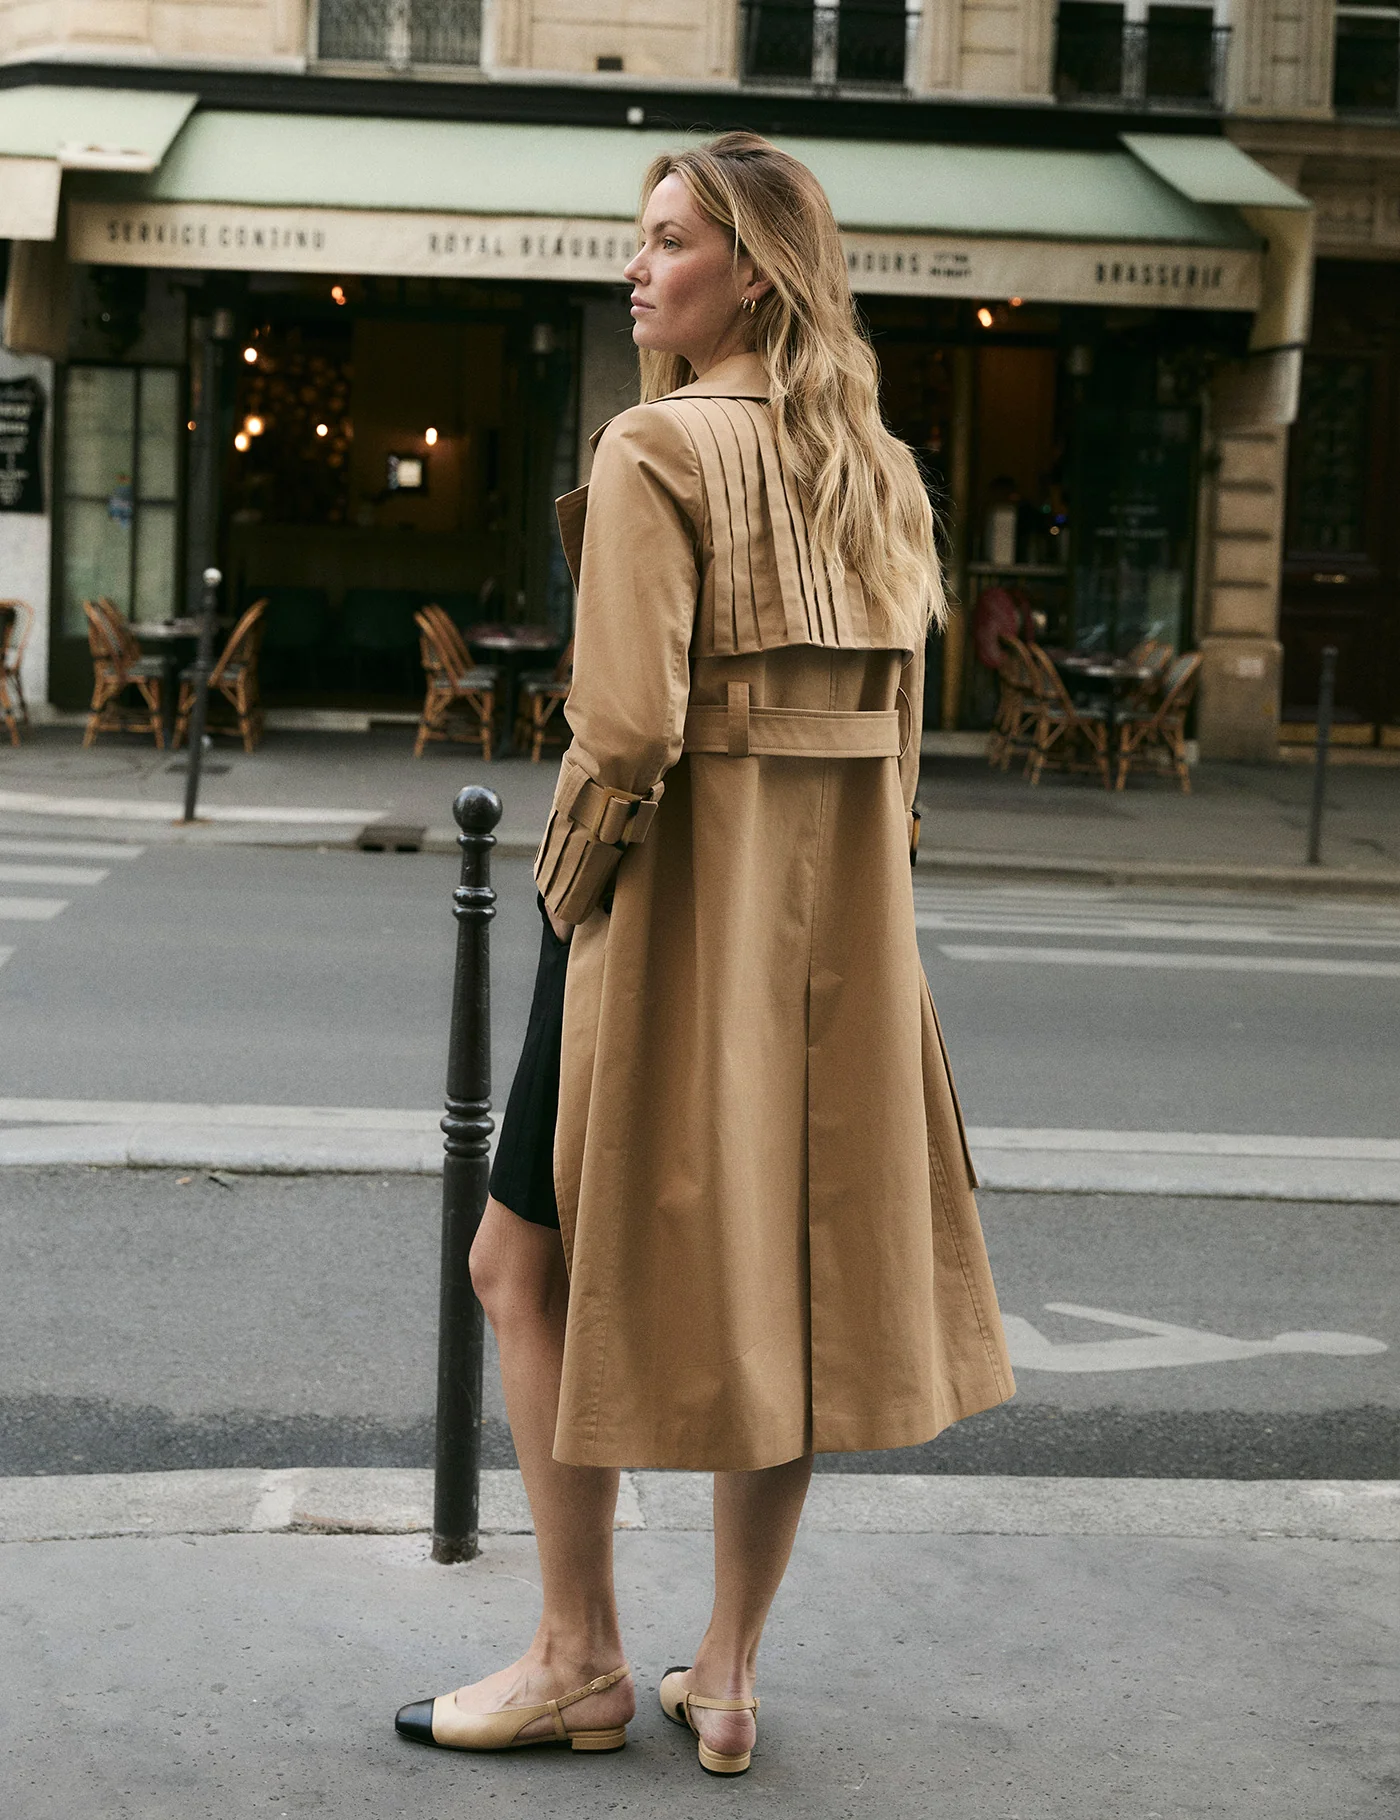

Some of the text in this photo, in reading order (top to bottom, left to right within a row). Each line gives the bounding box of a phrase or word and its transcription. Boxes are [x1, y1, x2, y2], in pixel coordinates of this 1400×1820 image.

[106, 219, 326, 251] SERVICE CONTINU
[429, 231, 505, 257] ROYAL
[1096, 262, 1223, 289] BRASSERIE
